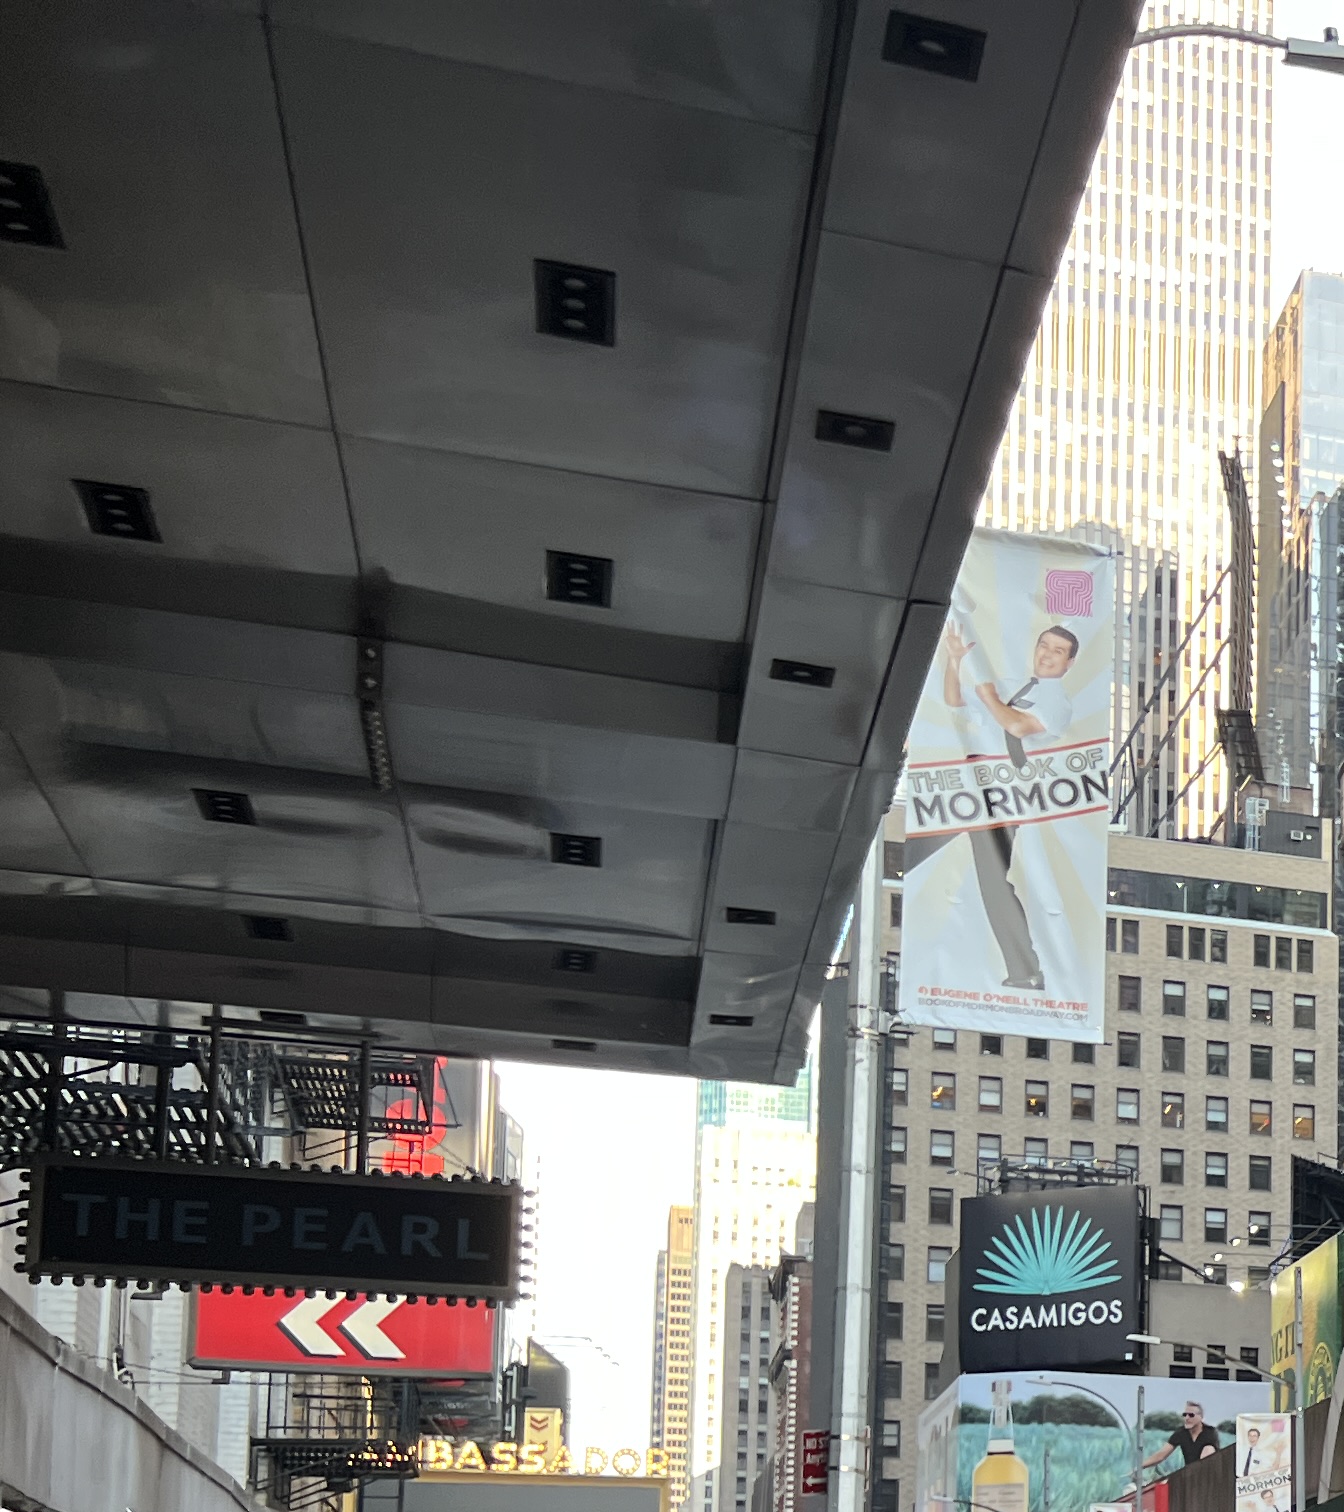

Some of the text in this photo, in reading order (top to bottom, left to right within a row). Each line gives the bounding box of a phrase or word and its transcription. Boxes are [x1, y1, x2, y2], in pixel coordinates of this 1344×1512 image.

[908, 747, 1104, 795] THE BOOK OF
[912, 769, 1109, 828] MORMON
[930, 986, 981, 1001] EUGENE
[1032, 997, 1089, 1012] THEATRE
[62, 1193, 489, 1262] THE PEARL
[970, 1299, 1123, 1332] CASAMIGOS
[1237, 1474, 1291, 1494] MORMON
